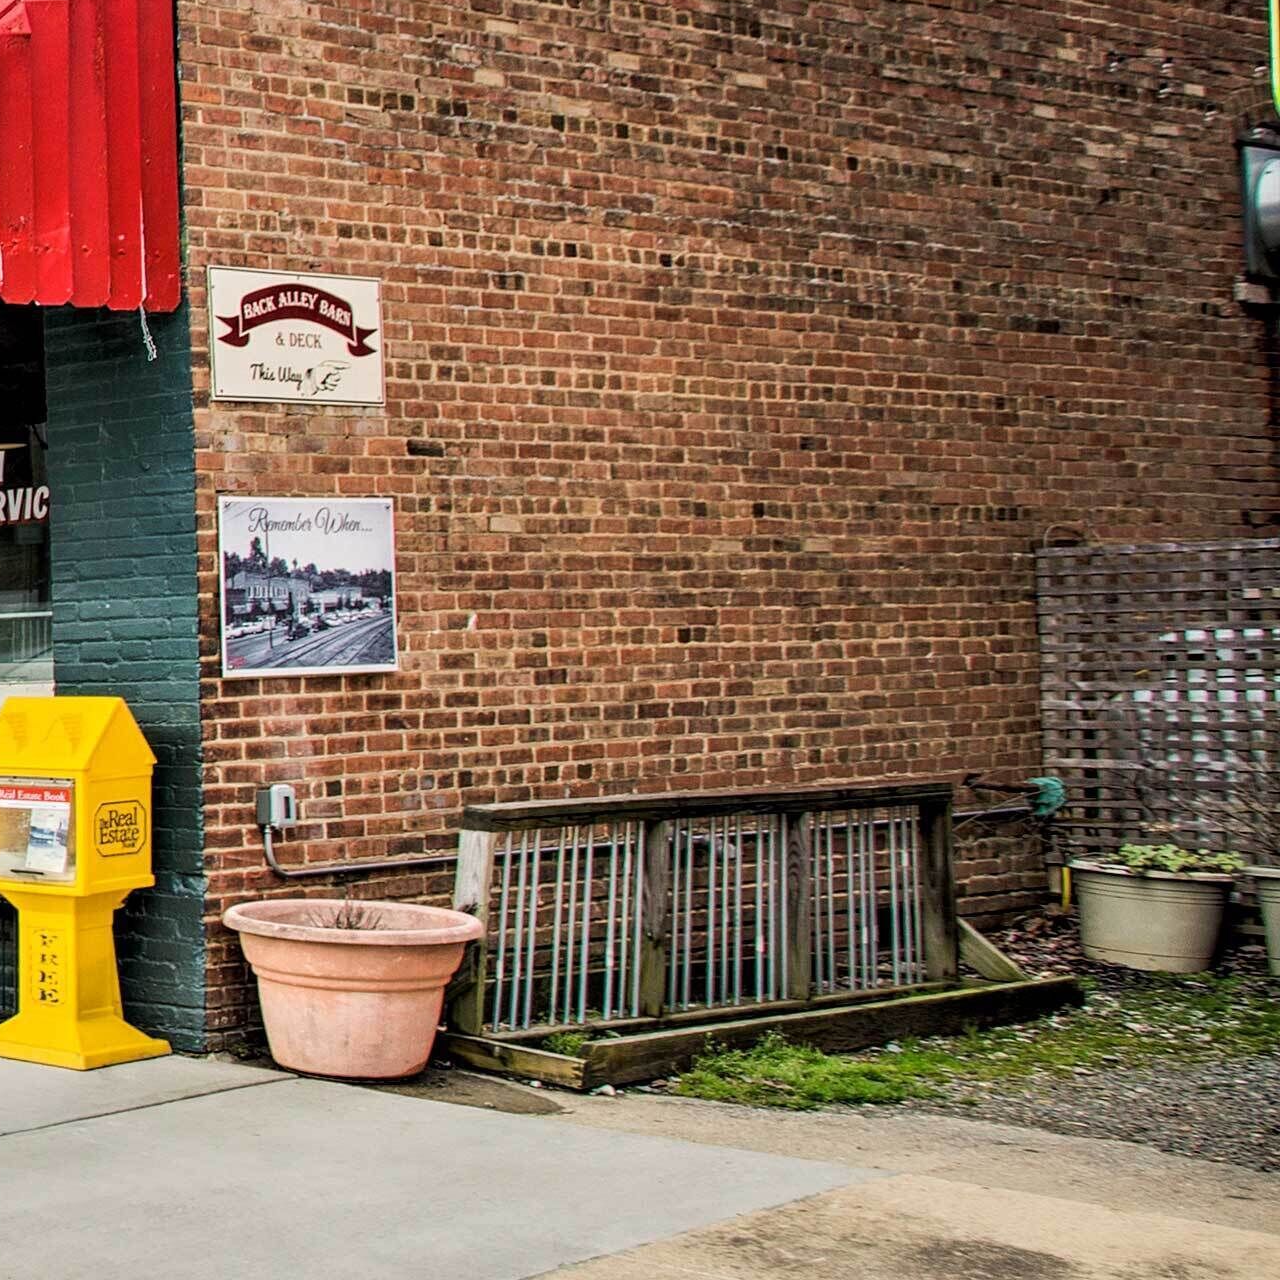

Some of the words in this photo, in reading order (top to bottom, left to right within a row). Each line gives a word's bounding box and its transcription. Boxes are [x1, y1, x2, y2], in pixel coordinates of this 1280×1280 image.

[243, 295, 277, 320] BACK
[278, 290, 319, 310] ALLEY
[319, 300, 353, 327] BARN
[275, 332, 285, 347] &
[290, 332, 322, 350] DECK
[250, 362, 276, 382] This
[278, 366, 305, 391] Way
[248, 507, 312, 533] Remember
[315, 507, 374, 535] When...
[43, 791, 66, 802] Book
[109, 806, 137, 828] Real
[100, 827, 140, 845] Estate
